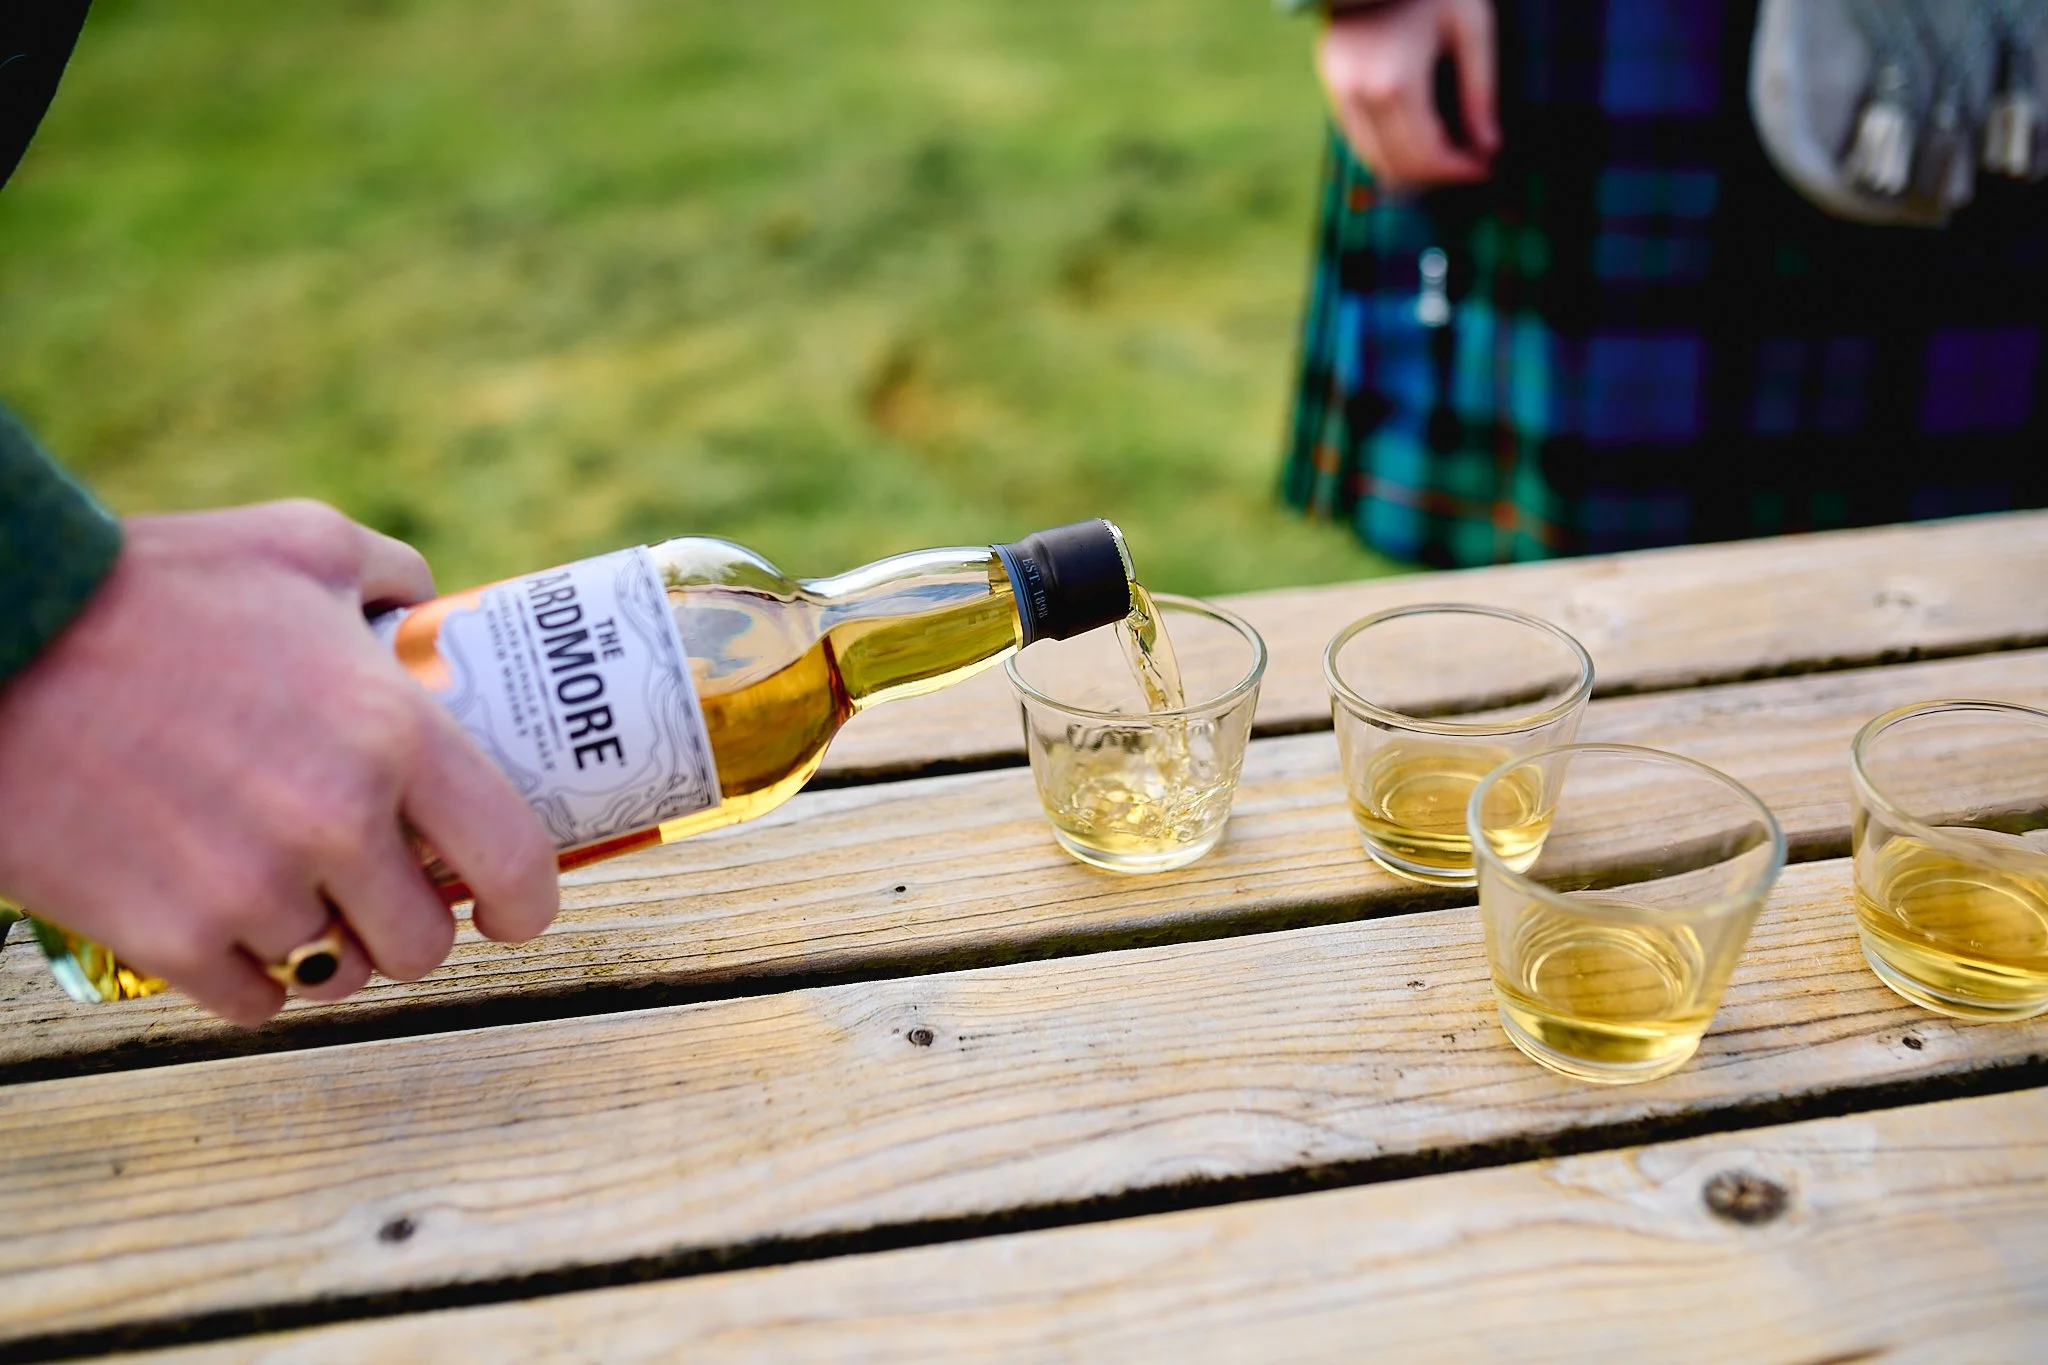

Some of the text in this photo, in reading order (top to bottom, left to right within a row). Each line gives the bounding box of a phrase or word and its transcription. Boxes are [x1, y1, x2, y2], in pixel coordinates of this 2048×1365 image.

[1022, 557, 1048, 619] EST. 1898
[594, 616, 625, 662] THE
[526, 572, 625, 770] ARDMORE
